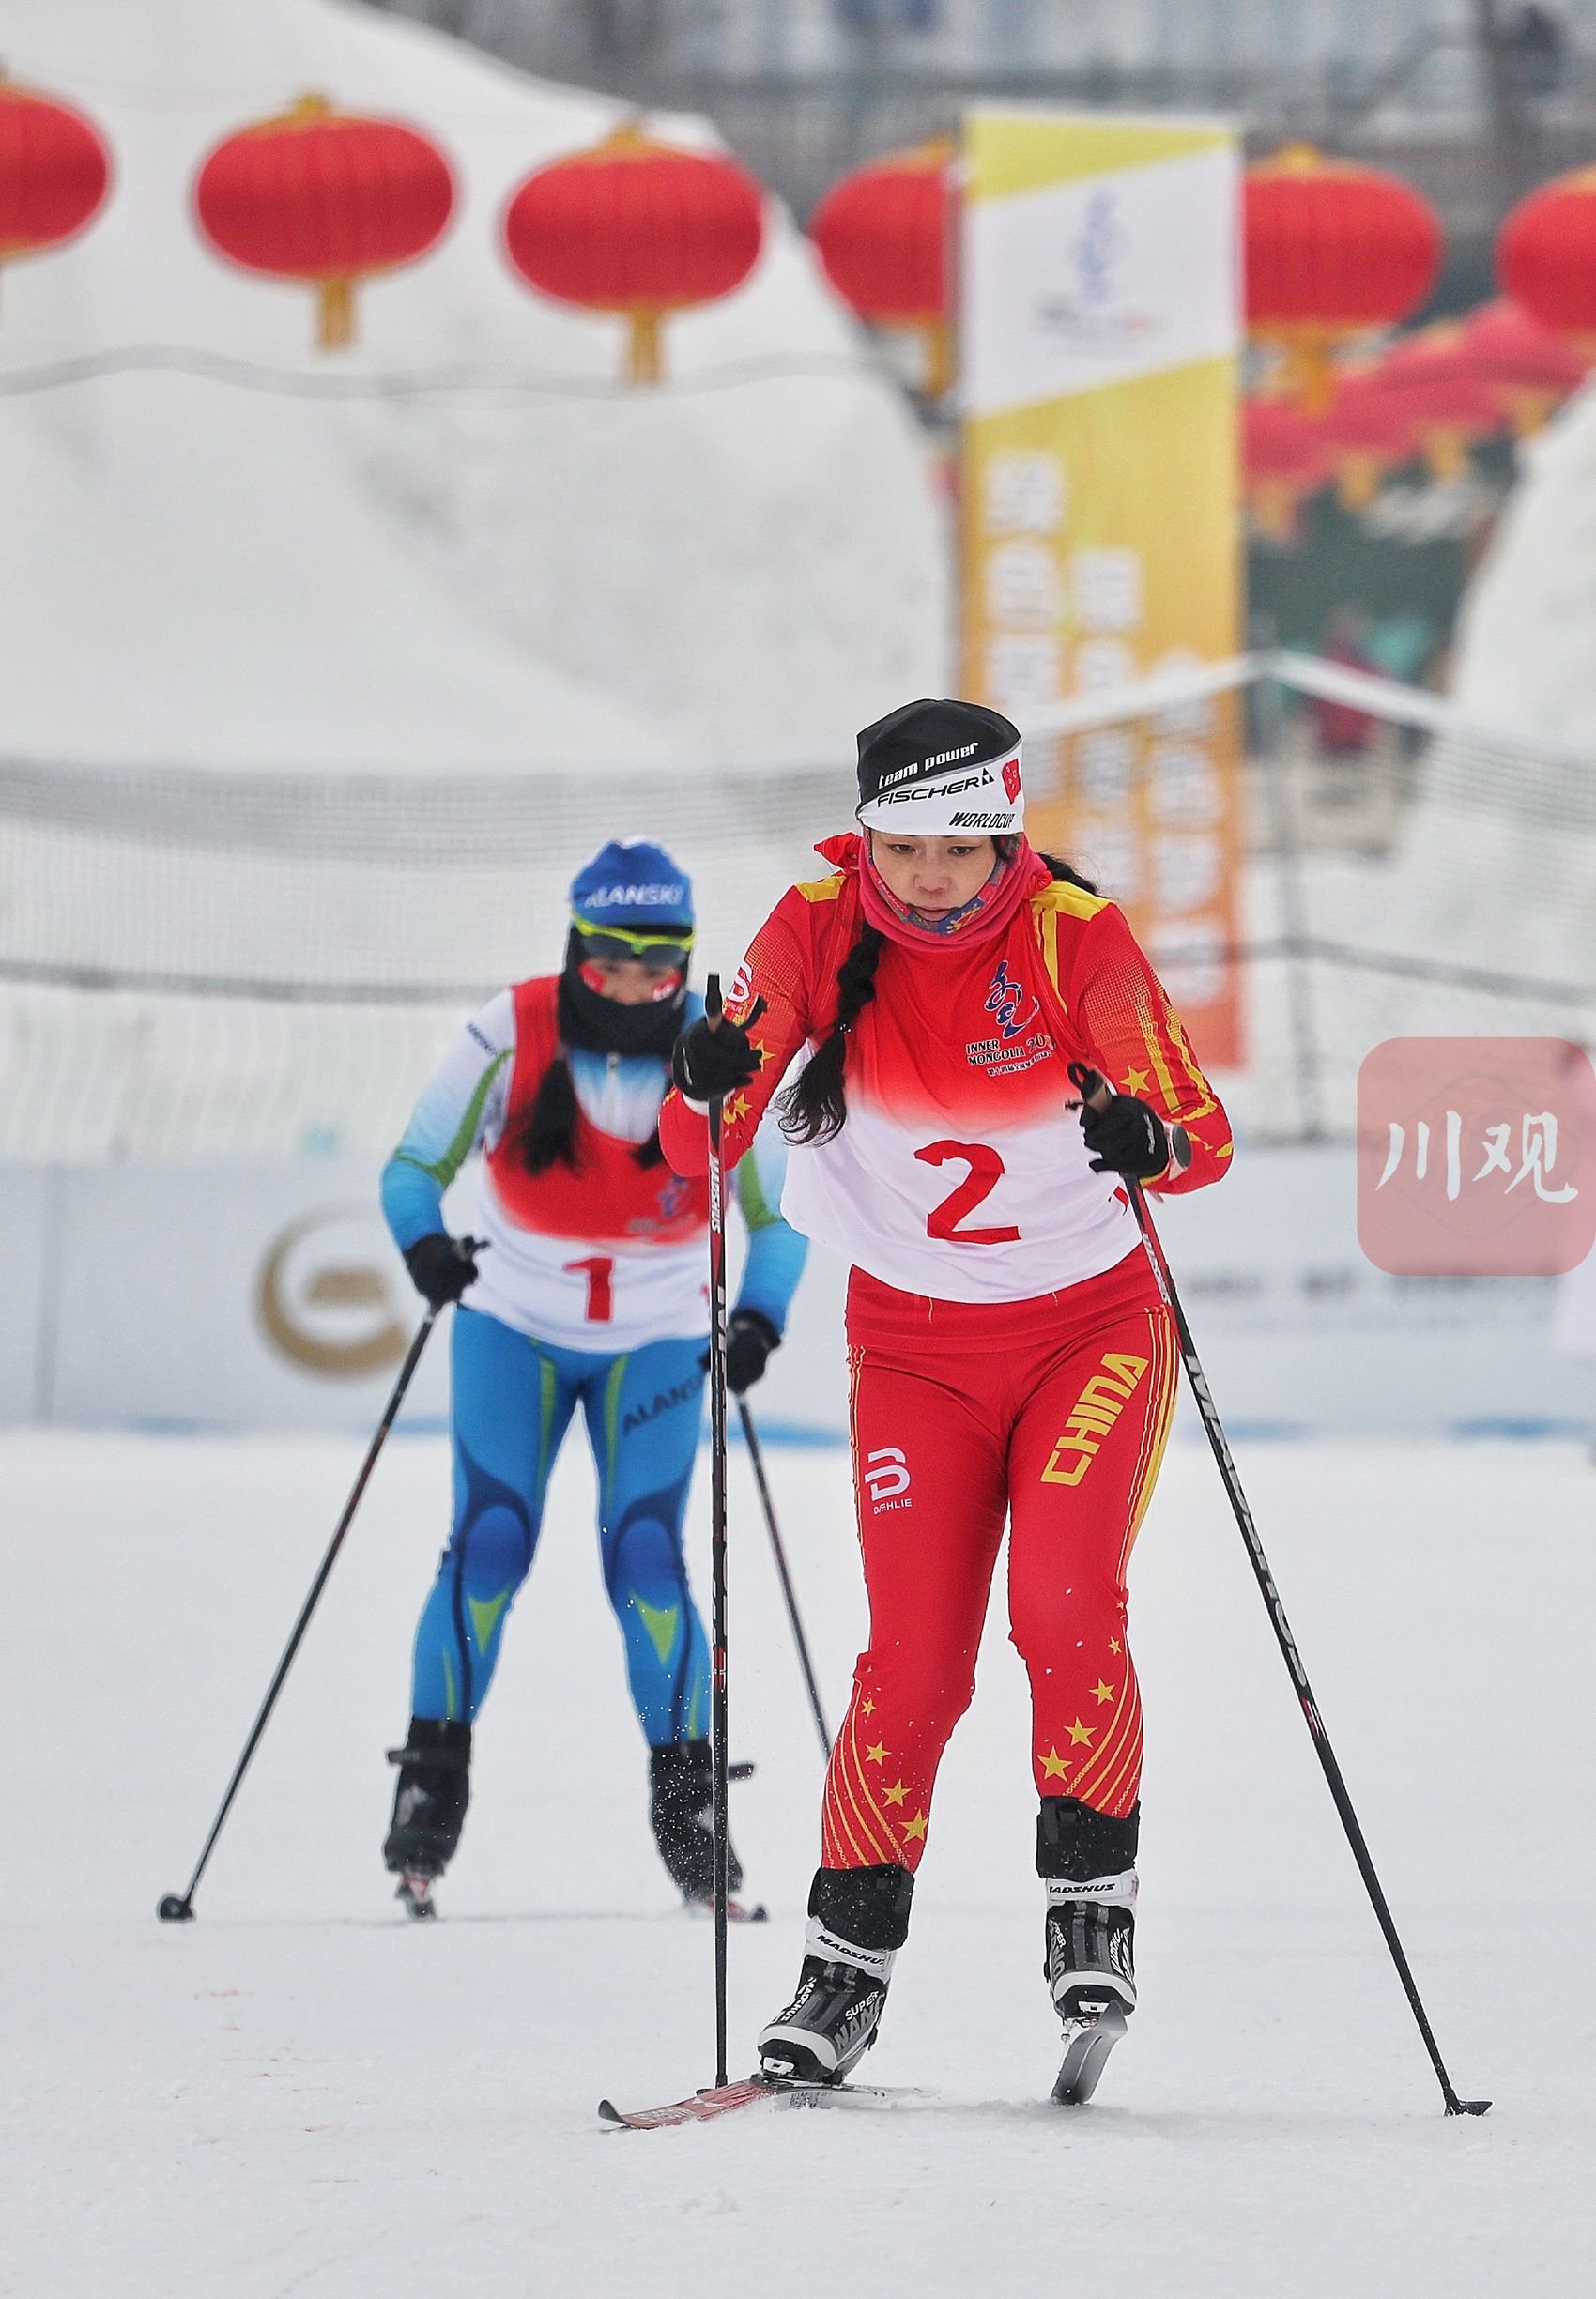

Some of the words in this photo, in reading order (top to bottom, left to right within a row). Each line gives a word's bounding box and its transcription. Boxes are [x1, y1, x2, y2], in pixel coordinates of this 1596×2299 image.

[878, 762, 917, 790] team
[925, 743, 979, 772] power
[877, 776, 979, 807] FISCHER
[948, 811, 1015, 828] WORLDCUP
[966, 1039, 1000, 1053] INNER
[967, 1046, 1025, 1066] MONGOLIA
[913, 1139, 1021, 1245] 2
[563, 1255, 614, 1325] 1
[1039, 1353, 1150, 1487] CHINA
[845, 1990, 881, 2021] SUPER
